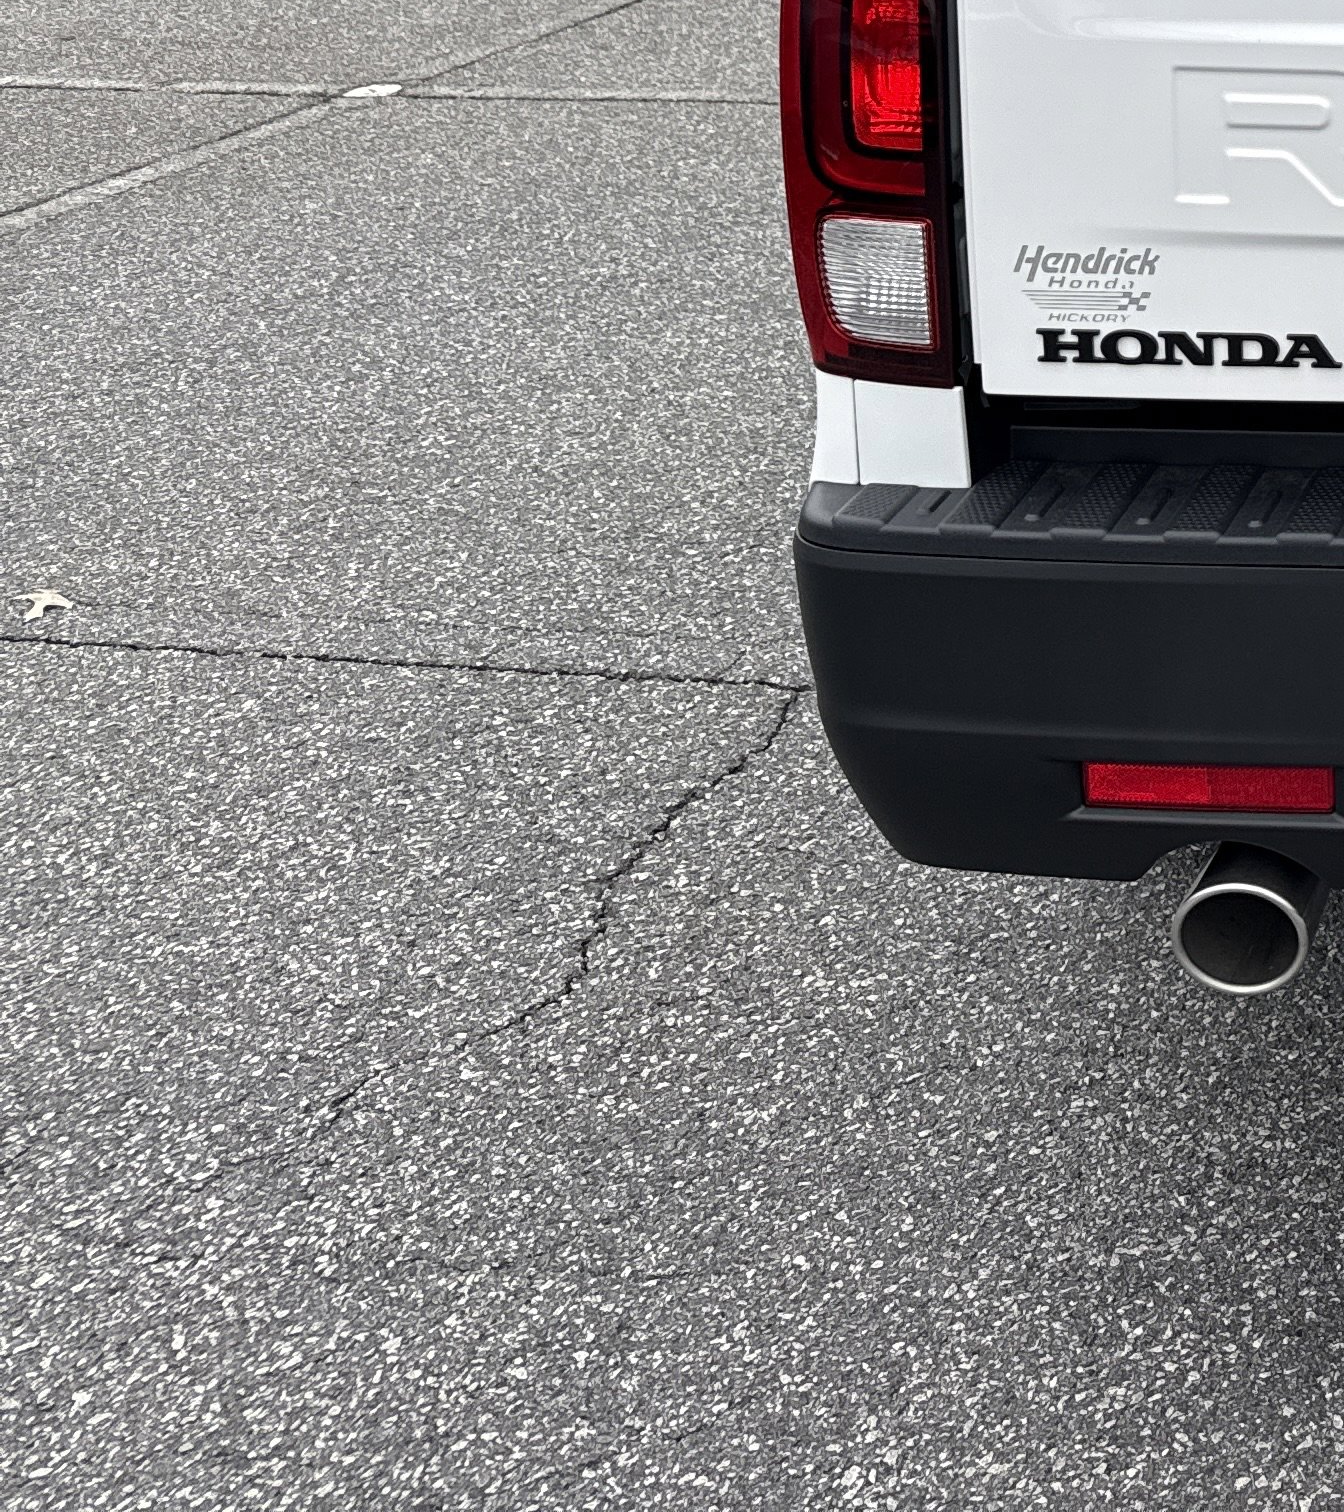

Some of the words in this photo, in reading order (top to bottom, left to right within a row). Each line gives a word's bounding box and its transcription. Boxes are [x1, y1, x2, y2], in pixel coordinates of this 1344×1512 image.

[1013, 244, 1160, 283] Hendrick
[1048, 312, 1132, 323] HICKORY
[1035, 327, 1343, 368] HONDA
